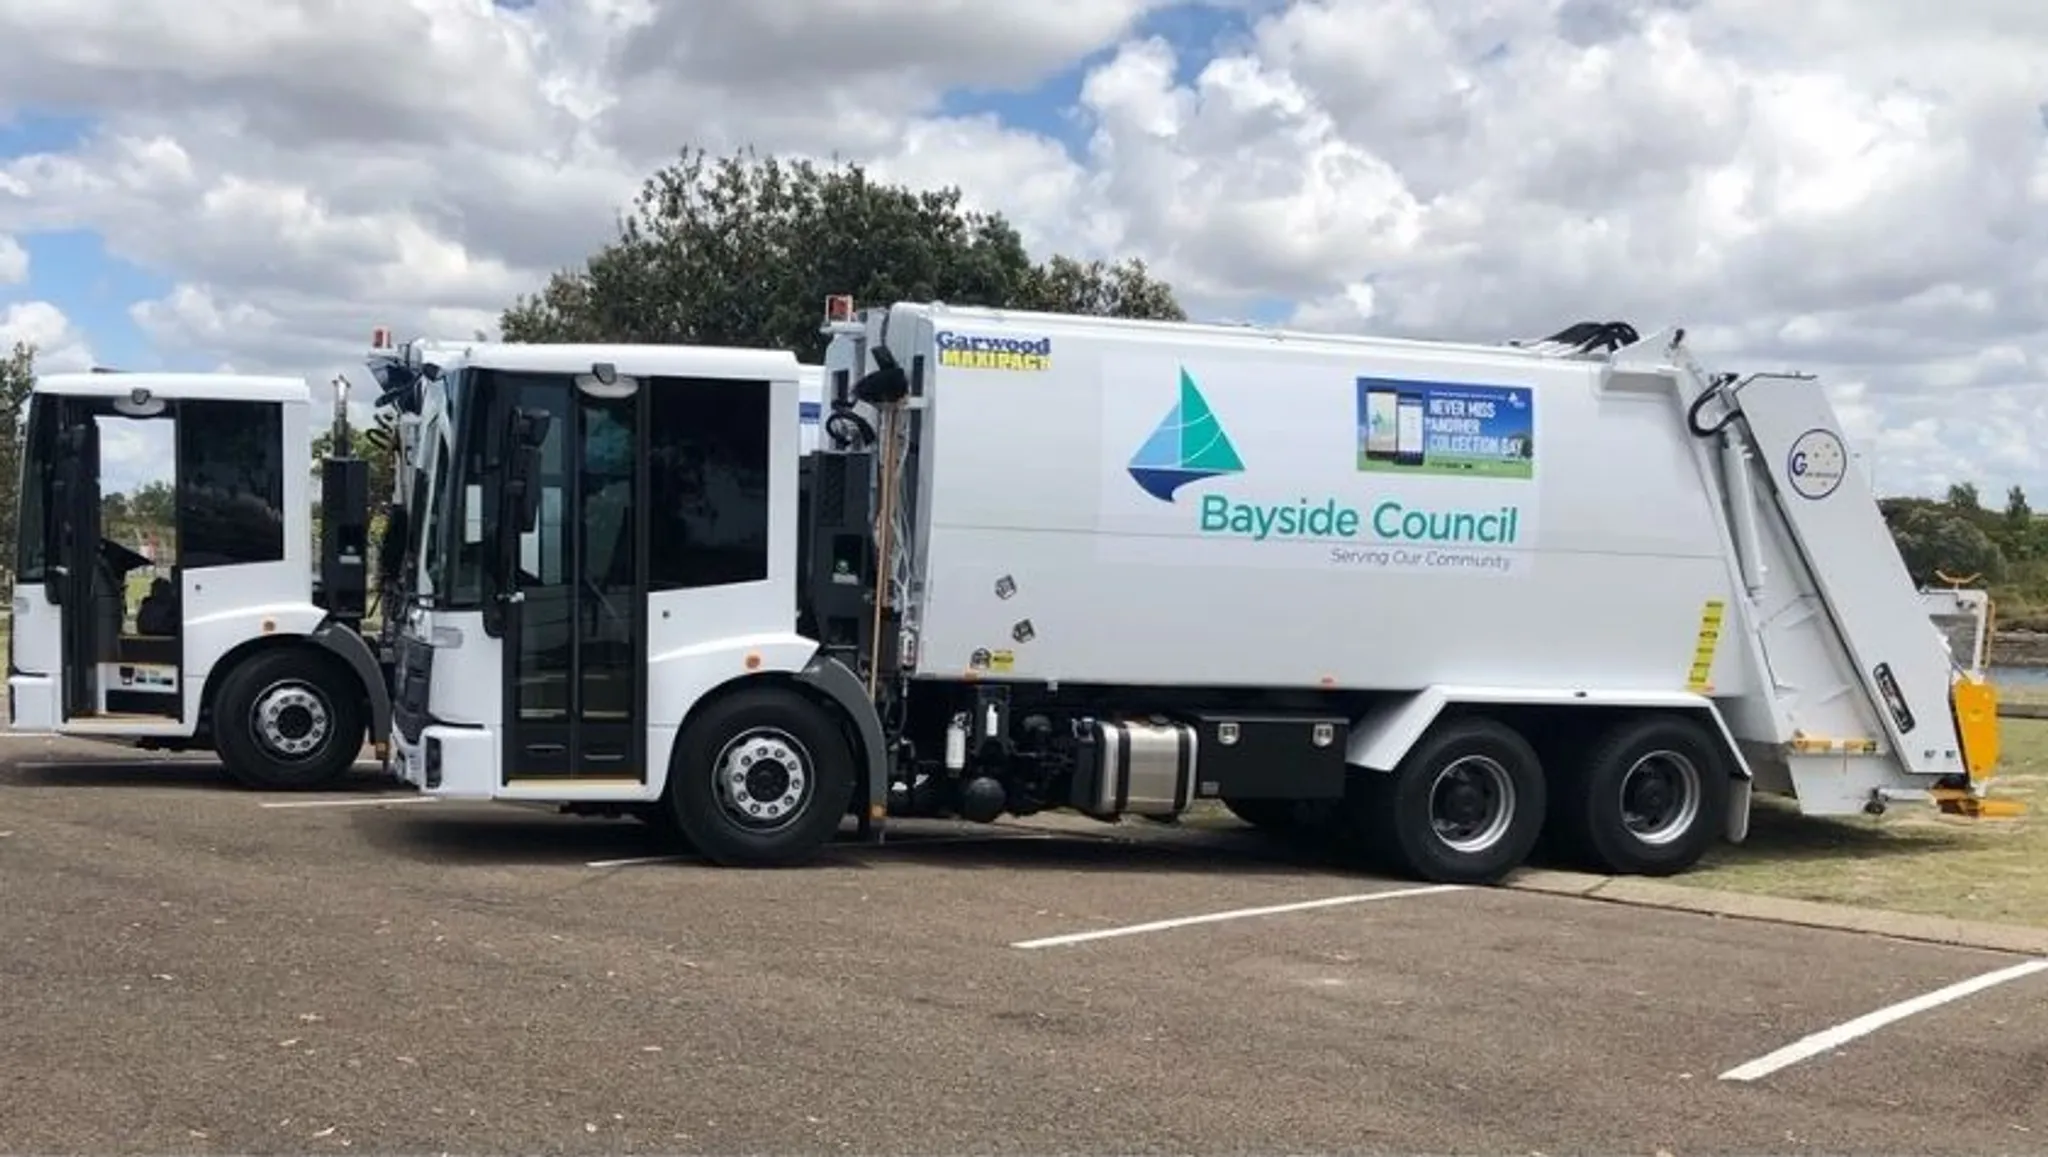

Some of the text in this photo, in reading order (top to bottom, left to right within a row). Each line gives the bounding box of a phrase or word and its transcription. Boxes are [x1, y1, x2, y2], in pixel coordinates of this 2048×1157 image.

[936, 331, 1052, 356] Garwood
[1429, 399, 1496, 419] NEVER MISS
[1200, 495, 1518, 543] Bayside Council
[1330, 548, 1511, 571] Serving Our Community
